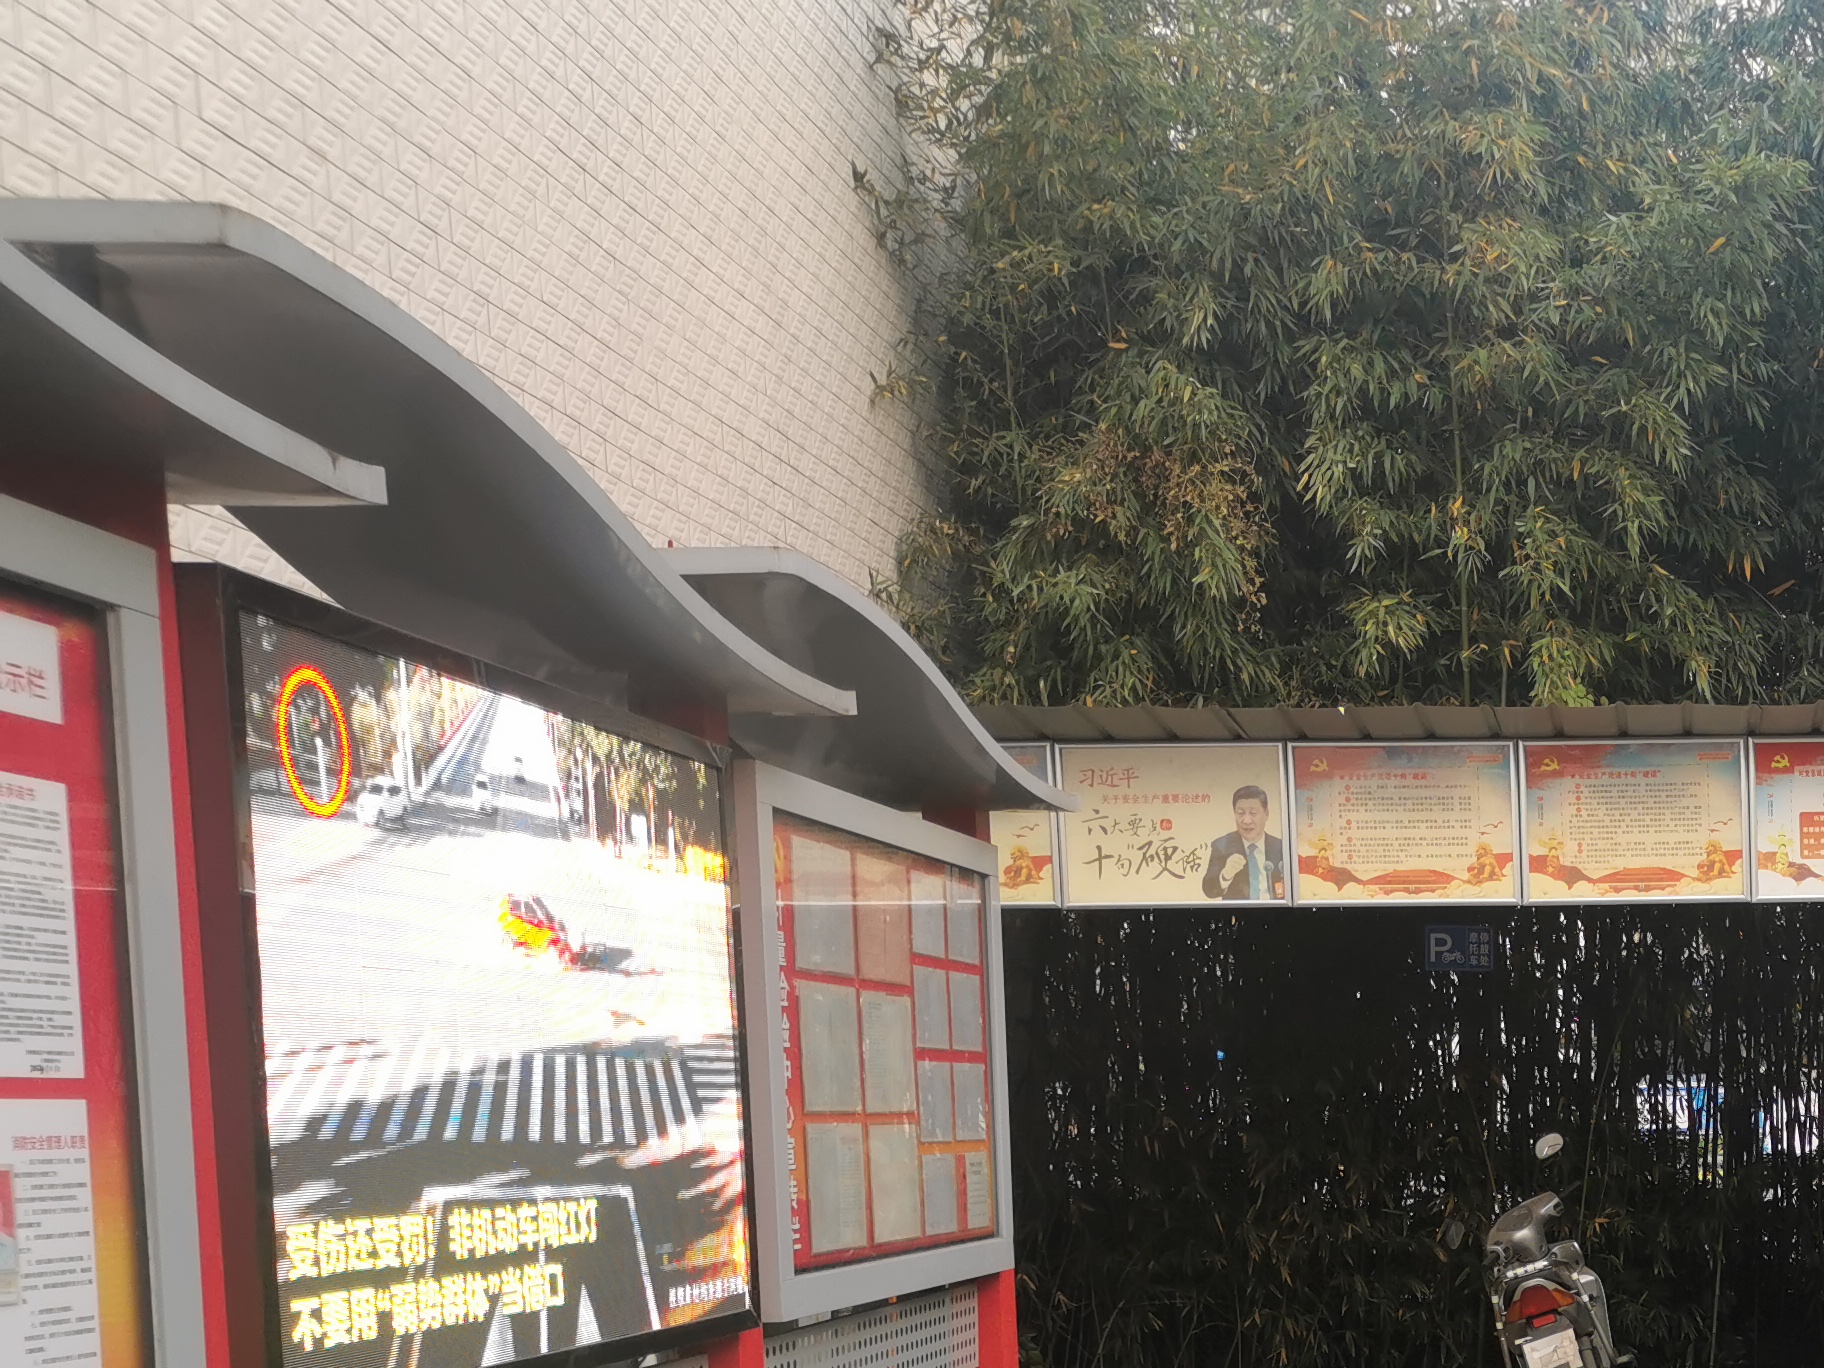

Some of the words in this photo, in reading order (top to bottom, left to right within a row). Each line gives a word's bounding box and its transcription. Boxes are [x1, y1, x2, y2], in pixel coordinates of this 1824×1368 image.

[0, 661, 48, 699] 示栏
[1078, 766, 1140, 789] 习近平
[1101, 793, 1212, 805] 关于安全生产重要论述的
[1430, 933, 1453, 962] P
